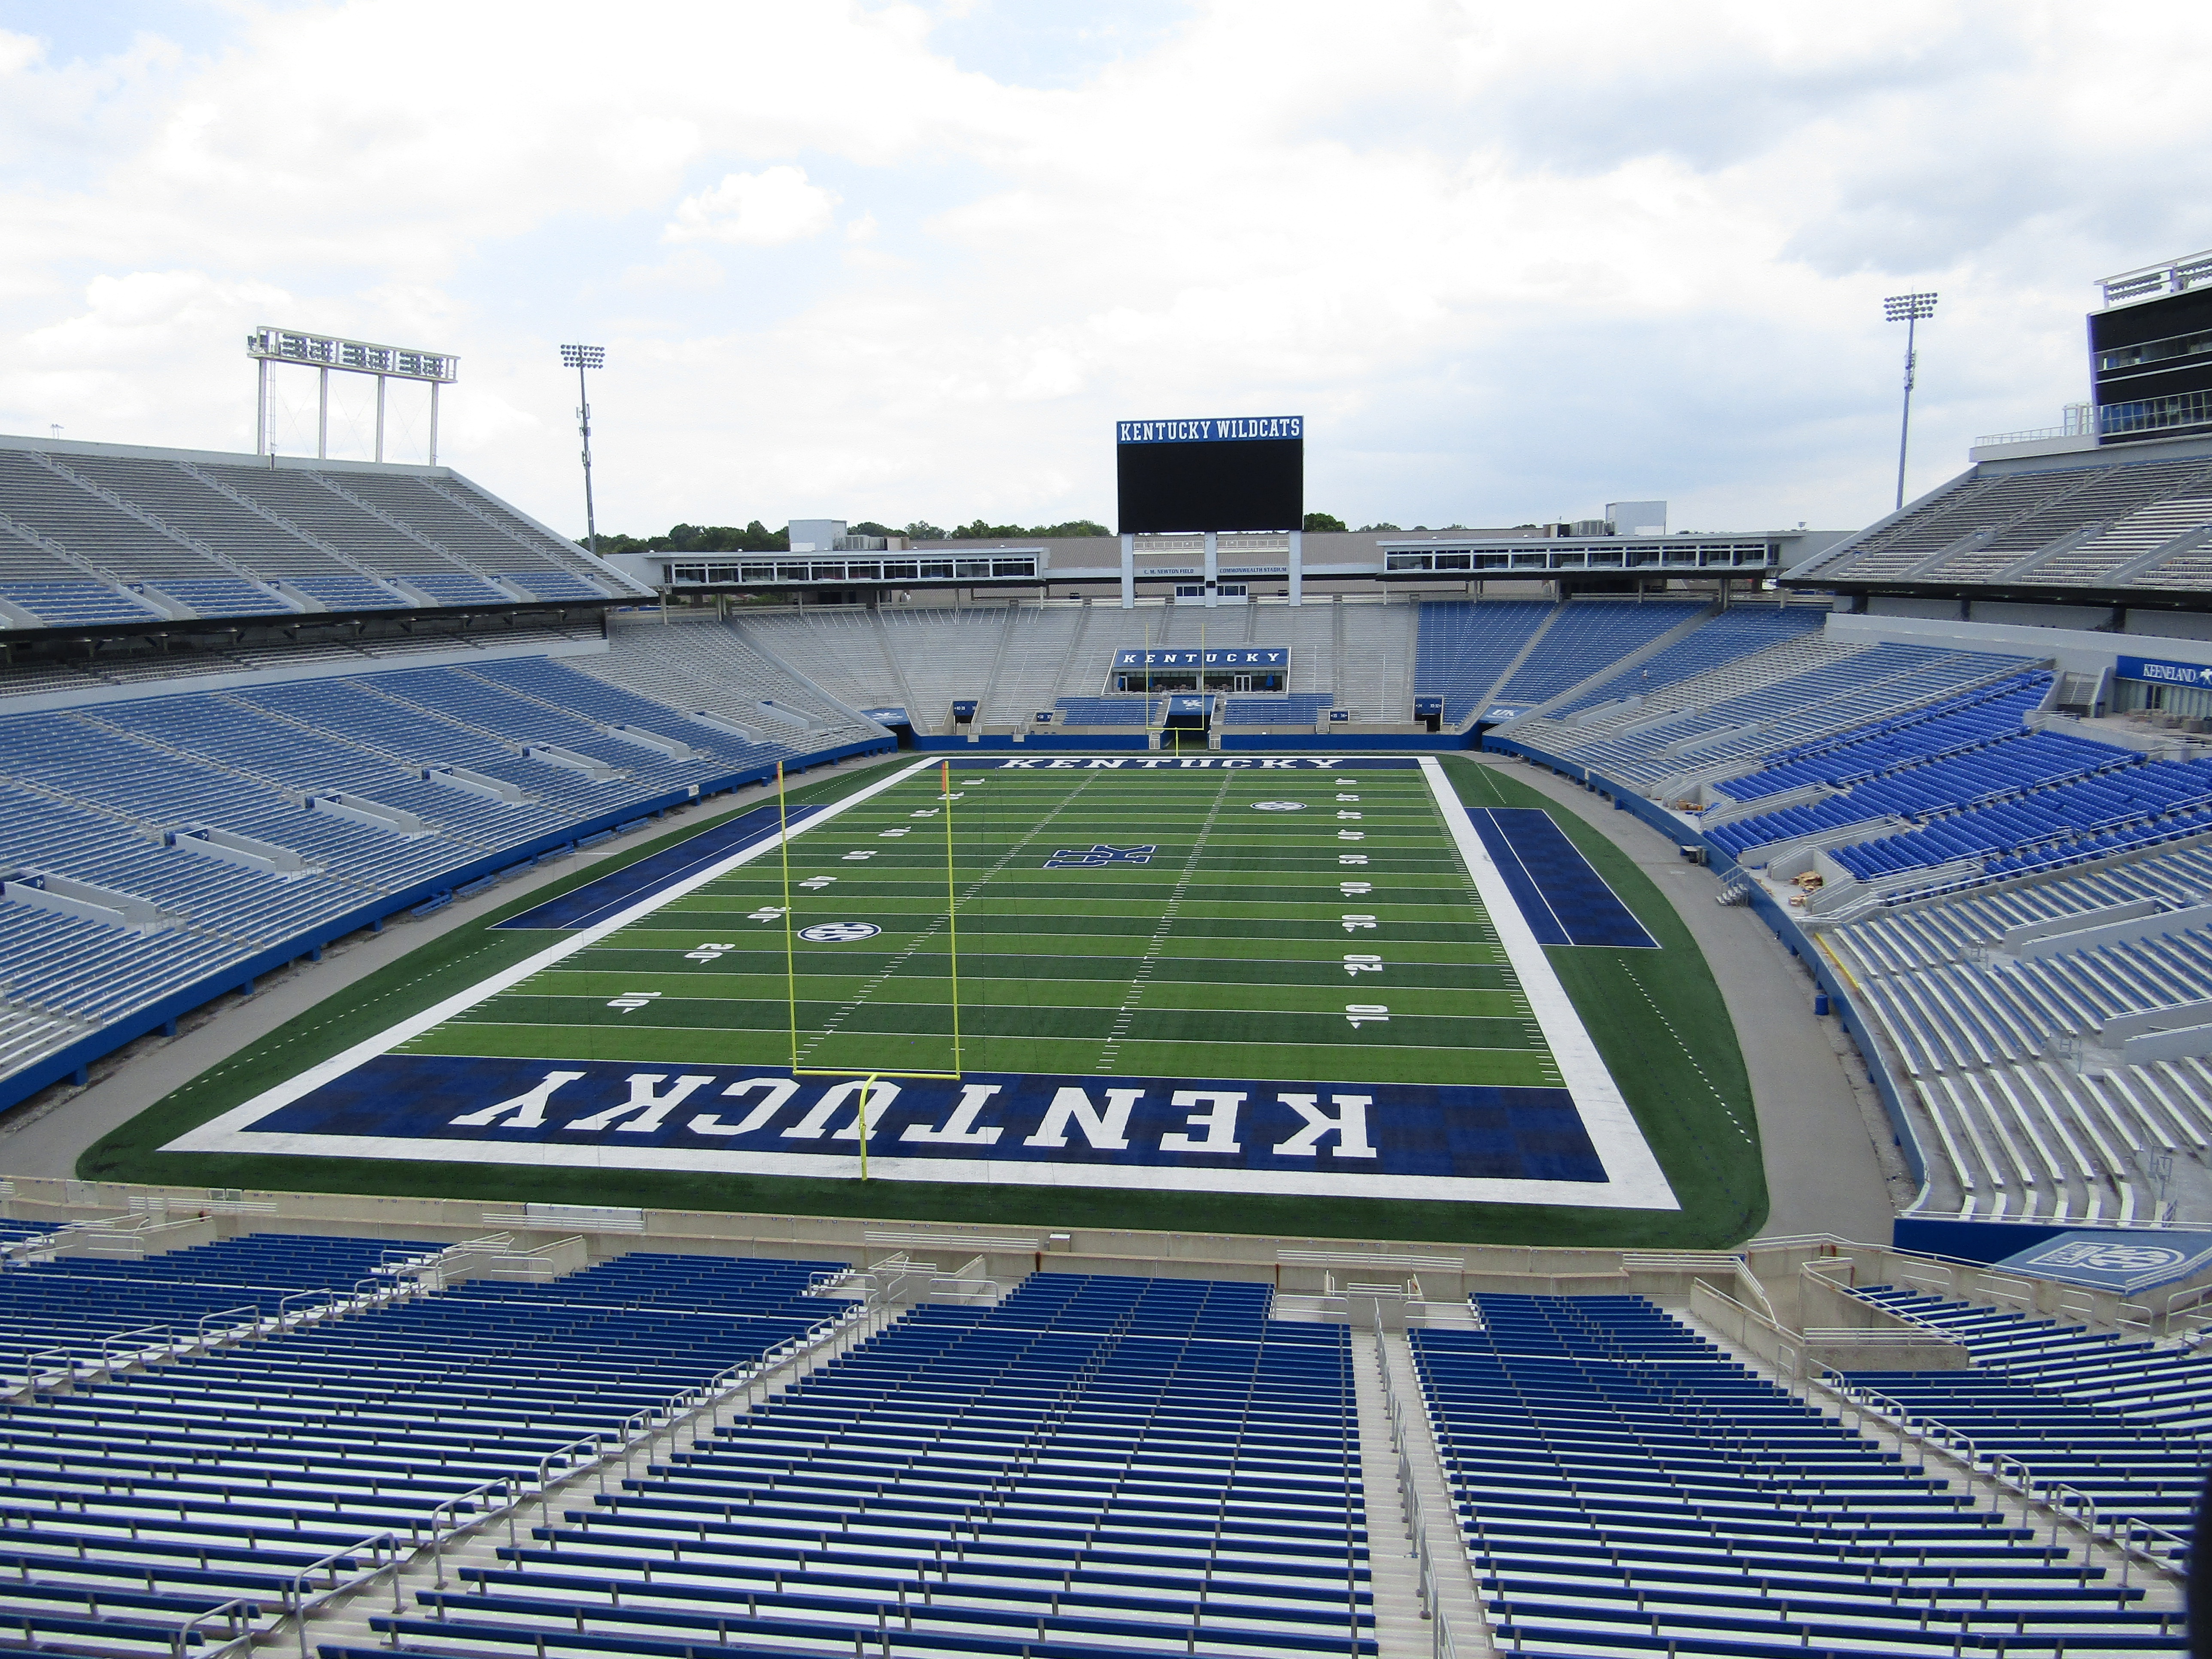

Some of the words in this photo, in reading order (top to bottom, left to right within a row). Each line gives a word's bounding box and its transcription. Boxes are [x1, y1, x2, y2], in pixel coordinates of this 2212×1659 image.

[1120, 420, 1211, 441] KENTUCKY
[1216, 418, 1300, 438] WILDCATS
[1123, 652, 1280, 663] KENTUCKY
[2143, 663, 2196, 683] KEENELAND
[998, 759, 1343, 769] KENTUCKY
[878, 828, 911, 837] 40
[842, 851, 878, 860] 50
[1338, 854, 1368, 865] 50
[799, 876, 837, 887] 40
[1340, 882, 1372, 894] 40
[747, 906, 792, 919] 30
[1341, 915, 1376, 929] 30
[803, 922, 878, 941] SEC
[684, 942, 736, 959] 20
[1343, 954, 1383, 972] 20
[607, 991, 662, 1007] 10
[1345, 1004, 1389, 1021] 10
[448, 1070, 1377, 1159] KENTUCKY
[2087, 1248, 2171, 1268] SEC
